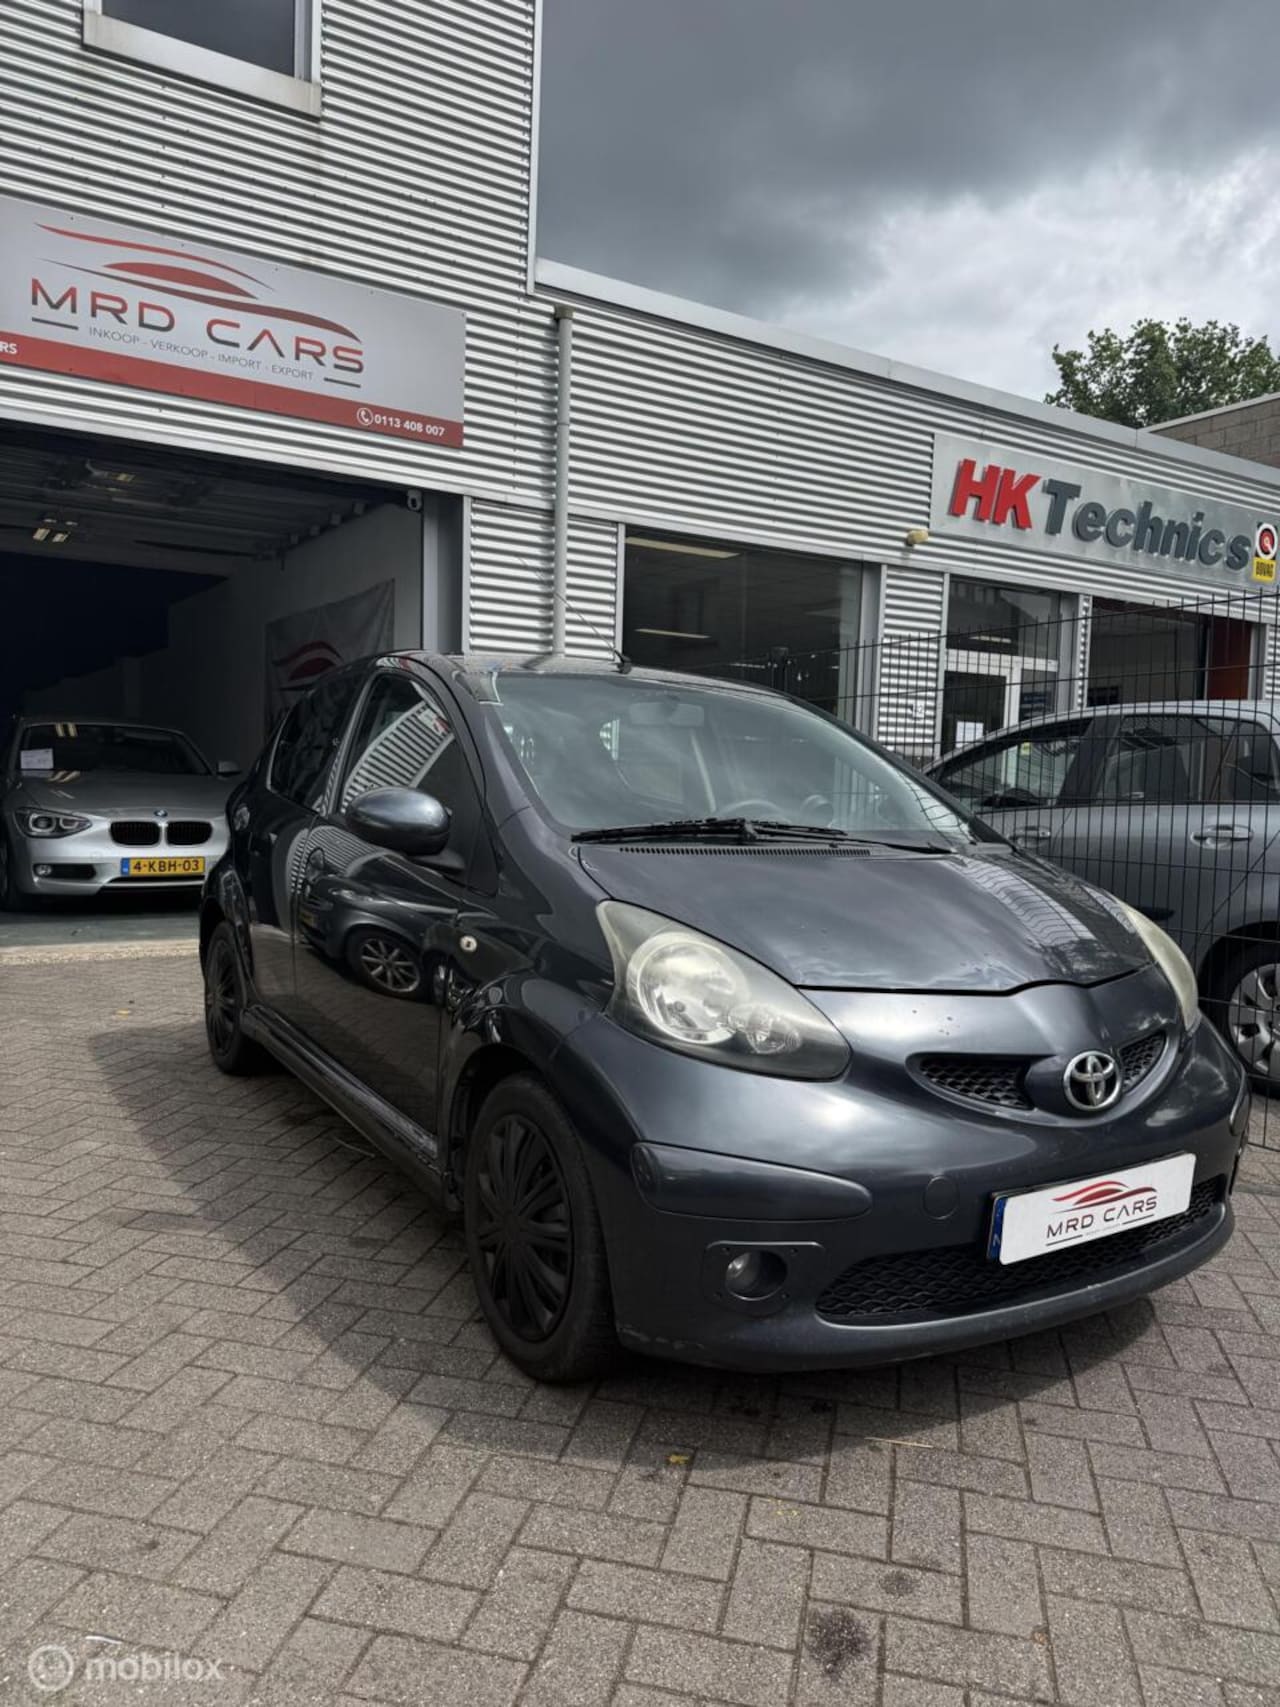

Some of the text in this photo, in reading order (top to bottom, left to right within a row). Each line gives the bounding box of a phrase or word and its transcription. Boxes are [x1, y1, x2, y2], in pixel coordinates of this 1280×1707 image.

[31, 278, 364, 374] MRD CARS
[89, 326, 140, 345] INKOOP
[150, 339, 208, 359] VERKOOP
[218, 353, 262, 370] IMPORT
[271, 364, 314, 380] EXPORT
[374, 414, 446, 437] 0113 408 007
[133, 859, 200, 873] 4-KBH-03
[1046, 1214, 1095, 1239] MRD
[1103, 1196, 1158, 1223] CARS
